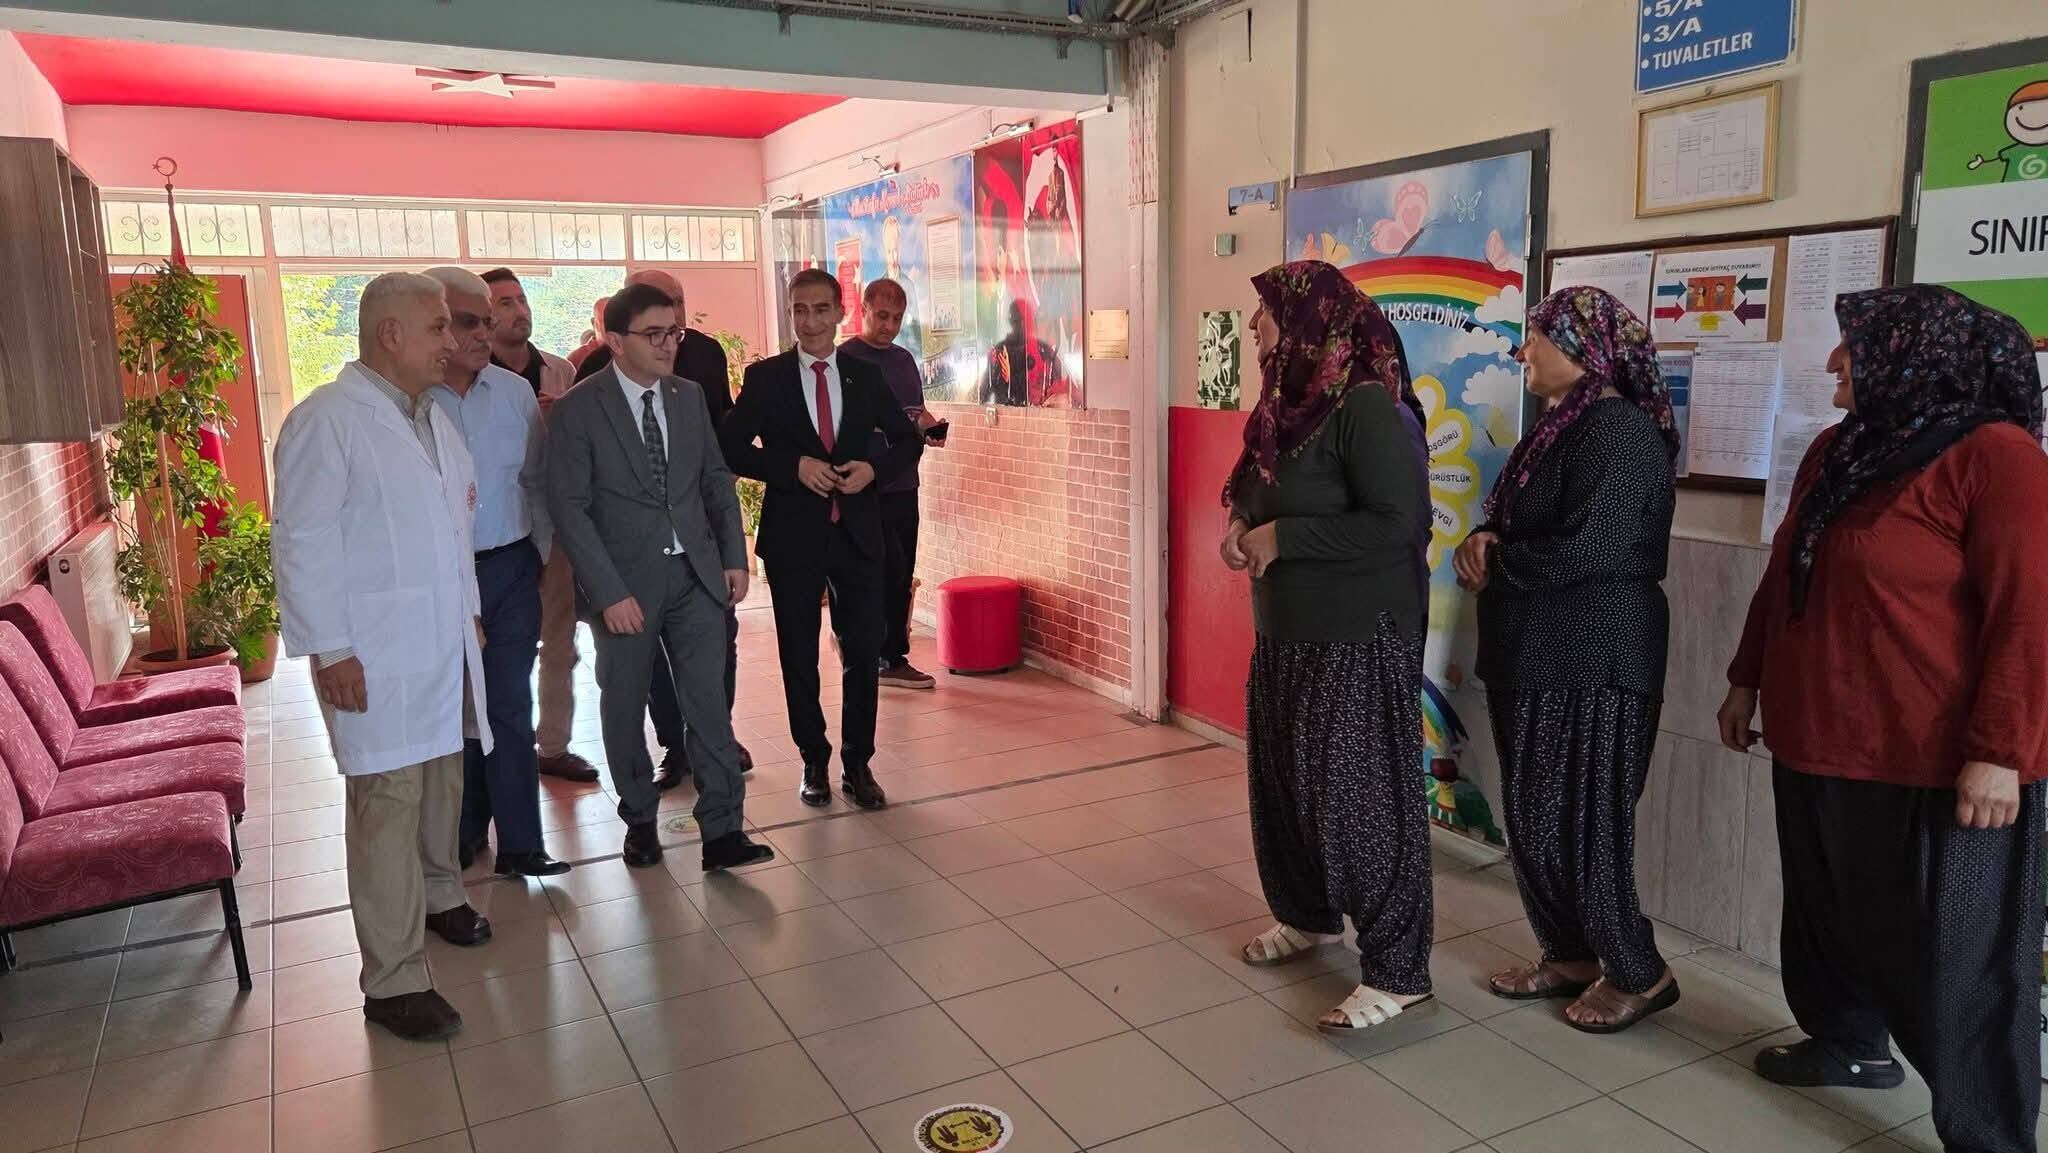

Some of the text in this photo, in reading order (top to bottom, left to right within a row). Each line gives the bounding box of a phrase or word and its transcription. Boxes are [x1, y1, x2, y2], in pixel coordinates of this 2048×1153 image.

[1653, 17, 1702, 42] 3/A
[1653, 32, 1753, 70] TUVALETLER
[1240, 187, 1264, 203] 7-A
[1388, 303, 1470, 331] HOŞGELDİNİZ
[1428, 430, 1459, 453] OŞGÖRÜ
[1430, 472, 1471, 483] ÜRÜSTLÜK
[1431, 507, 1453, 527] EVGİ
